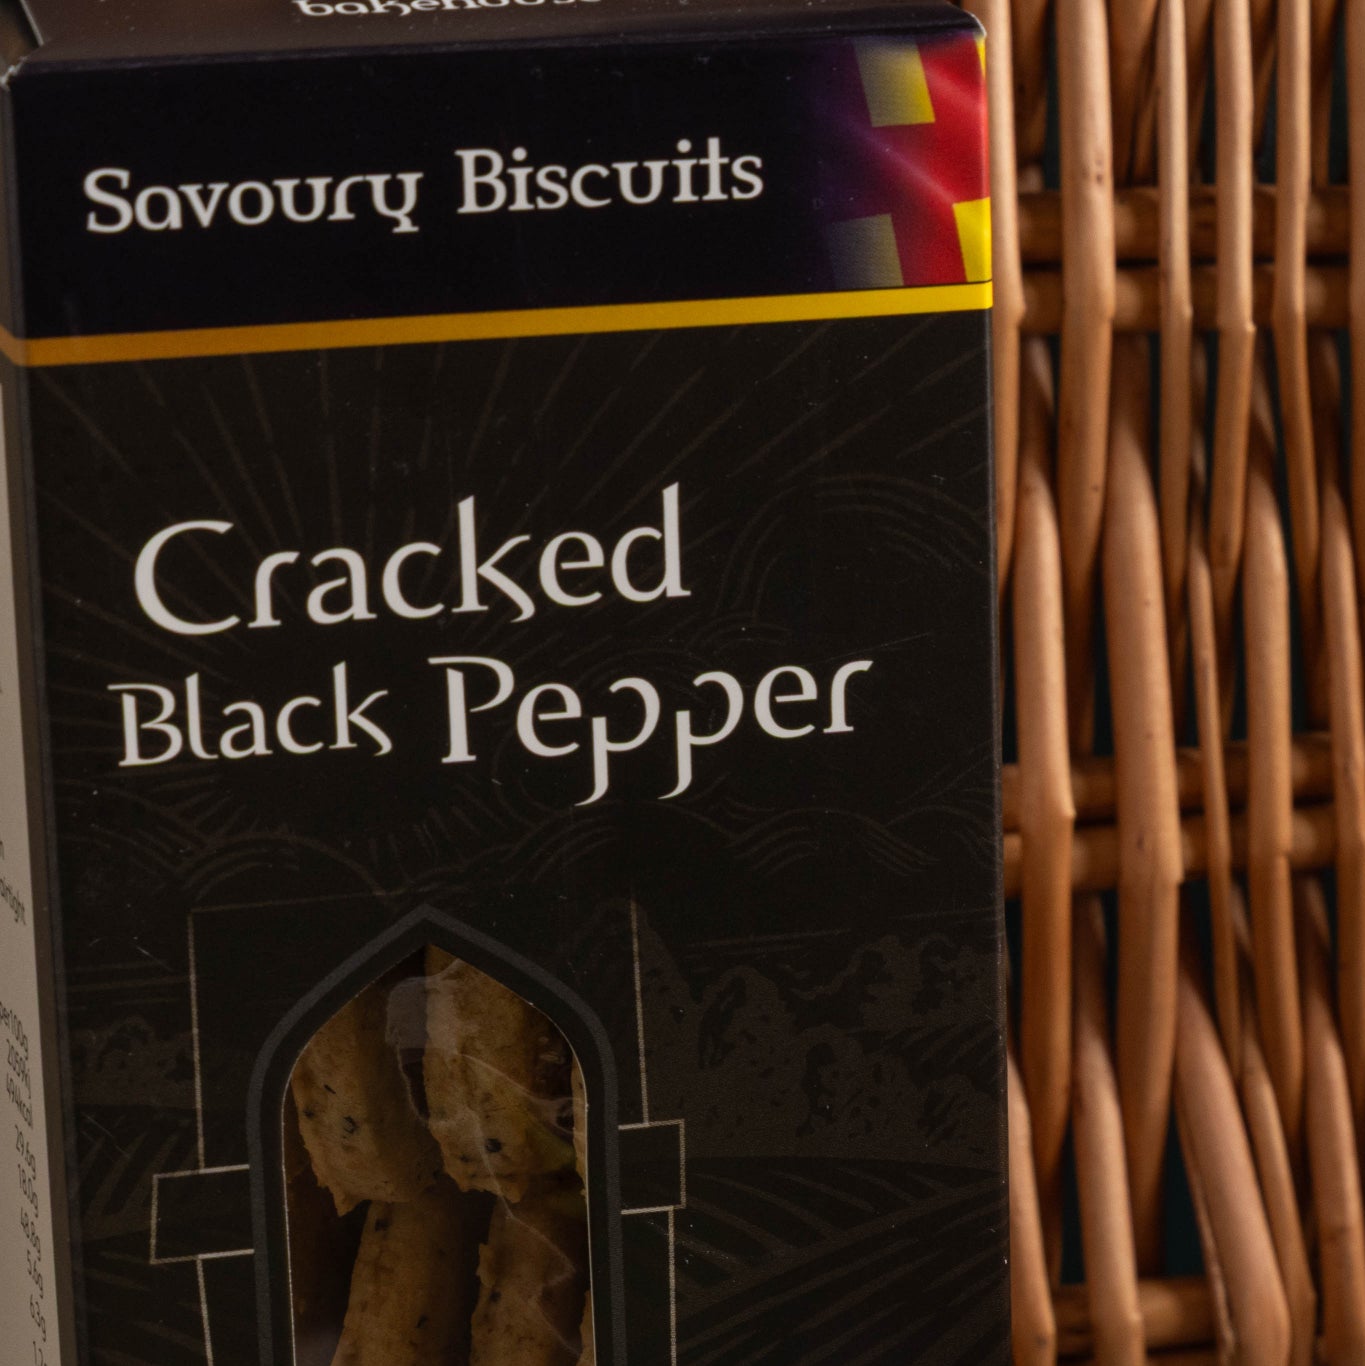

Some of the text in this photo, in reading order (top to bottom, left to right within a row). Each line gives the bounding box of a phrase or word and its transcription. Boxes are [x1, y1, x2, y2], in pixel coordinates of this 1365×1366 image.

[83, 136, 765, 235] Savoury Biscuits
[132, 481, 692, 638] Cracked
[107, 656, 874, 806] Black Pepper
